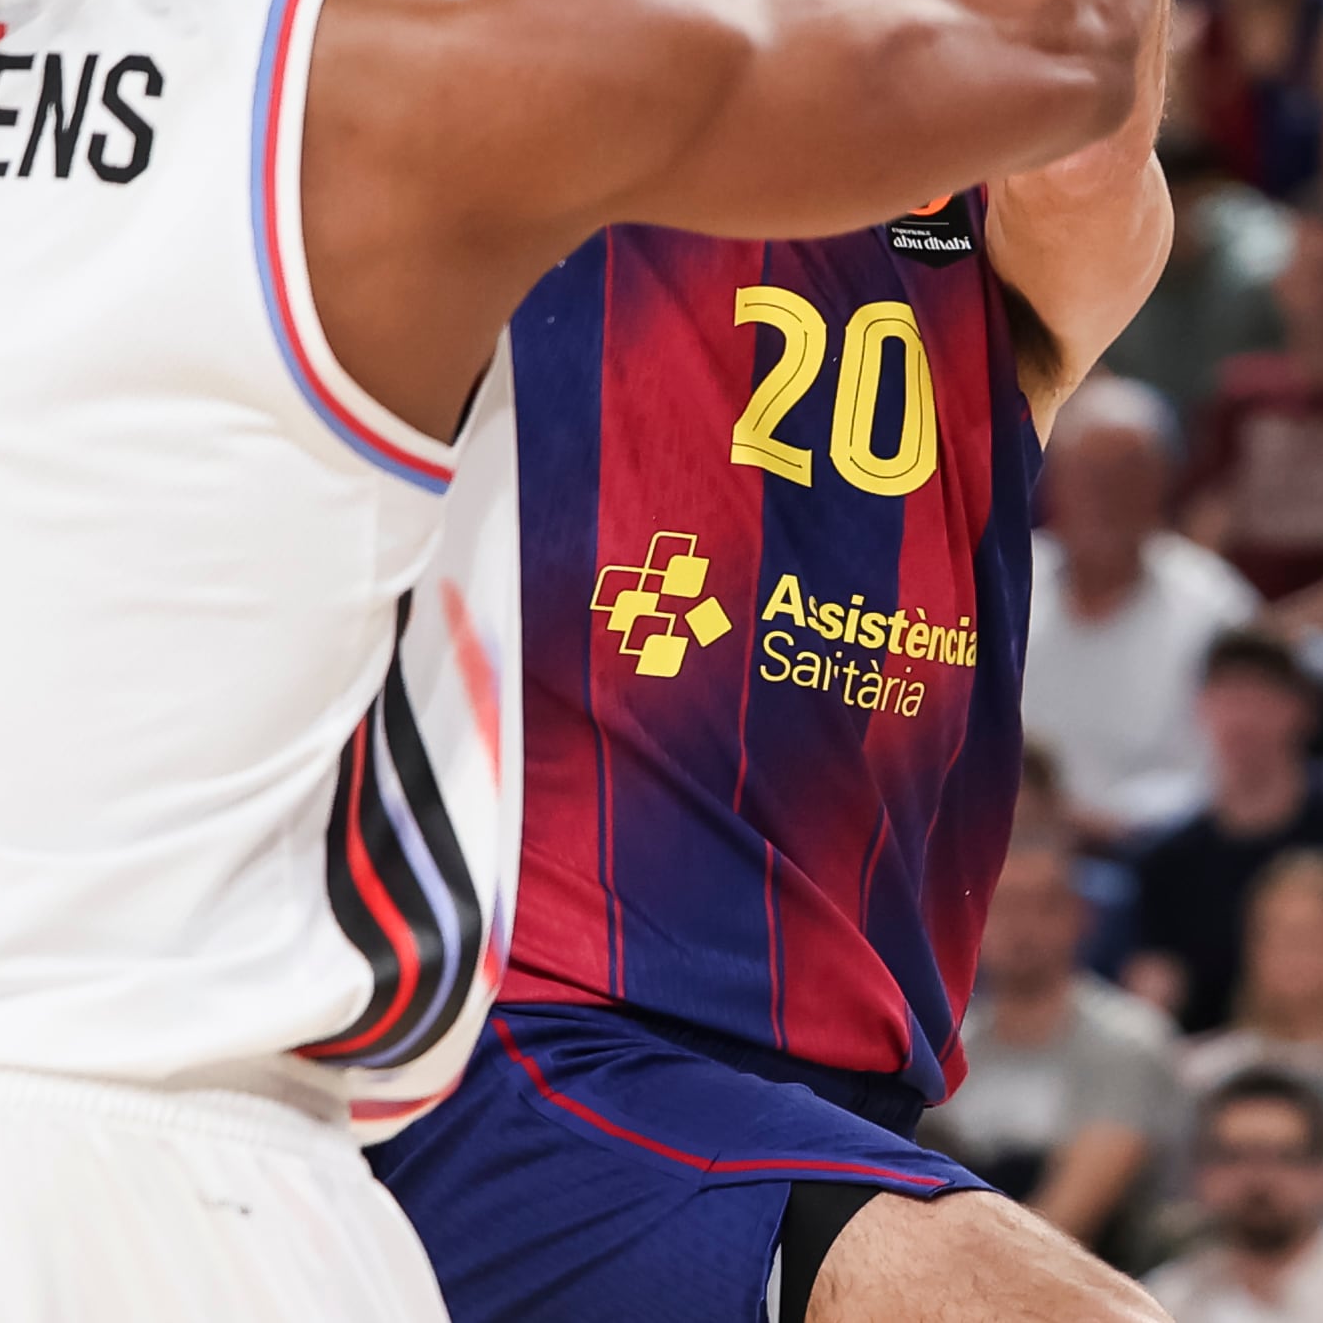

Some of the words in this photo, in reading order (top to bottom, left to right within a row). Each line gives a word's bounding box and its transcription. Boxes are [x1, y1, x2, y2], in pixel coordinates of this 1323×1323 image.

[893, 236, 923, 250] abu
[924, 236, 972, 251] dhabi
[730, 285, 938, 496] 20
